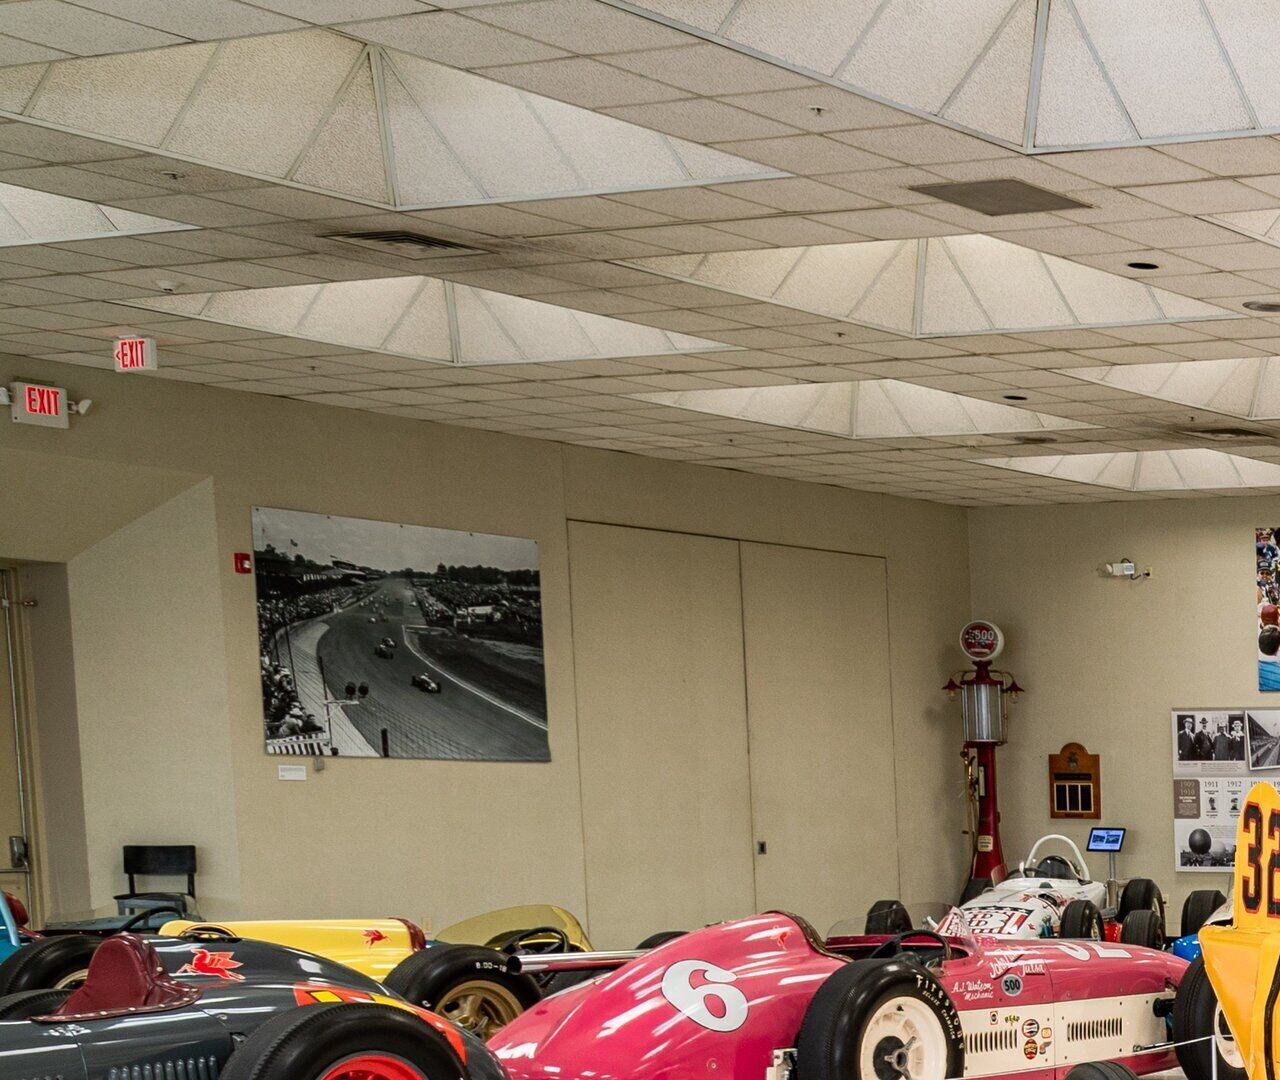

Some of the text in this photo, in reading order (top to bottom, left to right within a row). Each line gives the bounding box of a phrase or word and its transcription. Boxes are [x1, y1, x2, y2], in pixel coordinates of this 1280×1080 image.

[121, 340, 145, 368] EXIT
[26, 386, 60, 416] EXIT
[661, 959, 749, 1033] 6
[1004, 980, 1020, 991] 500
